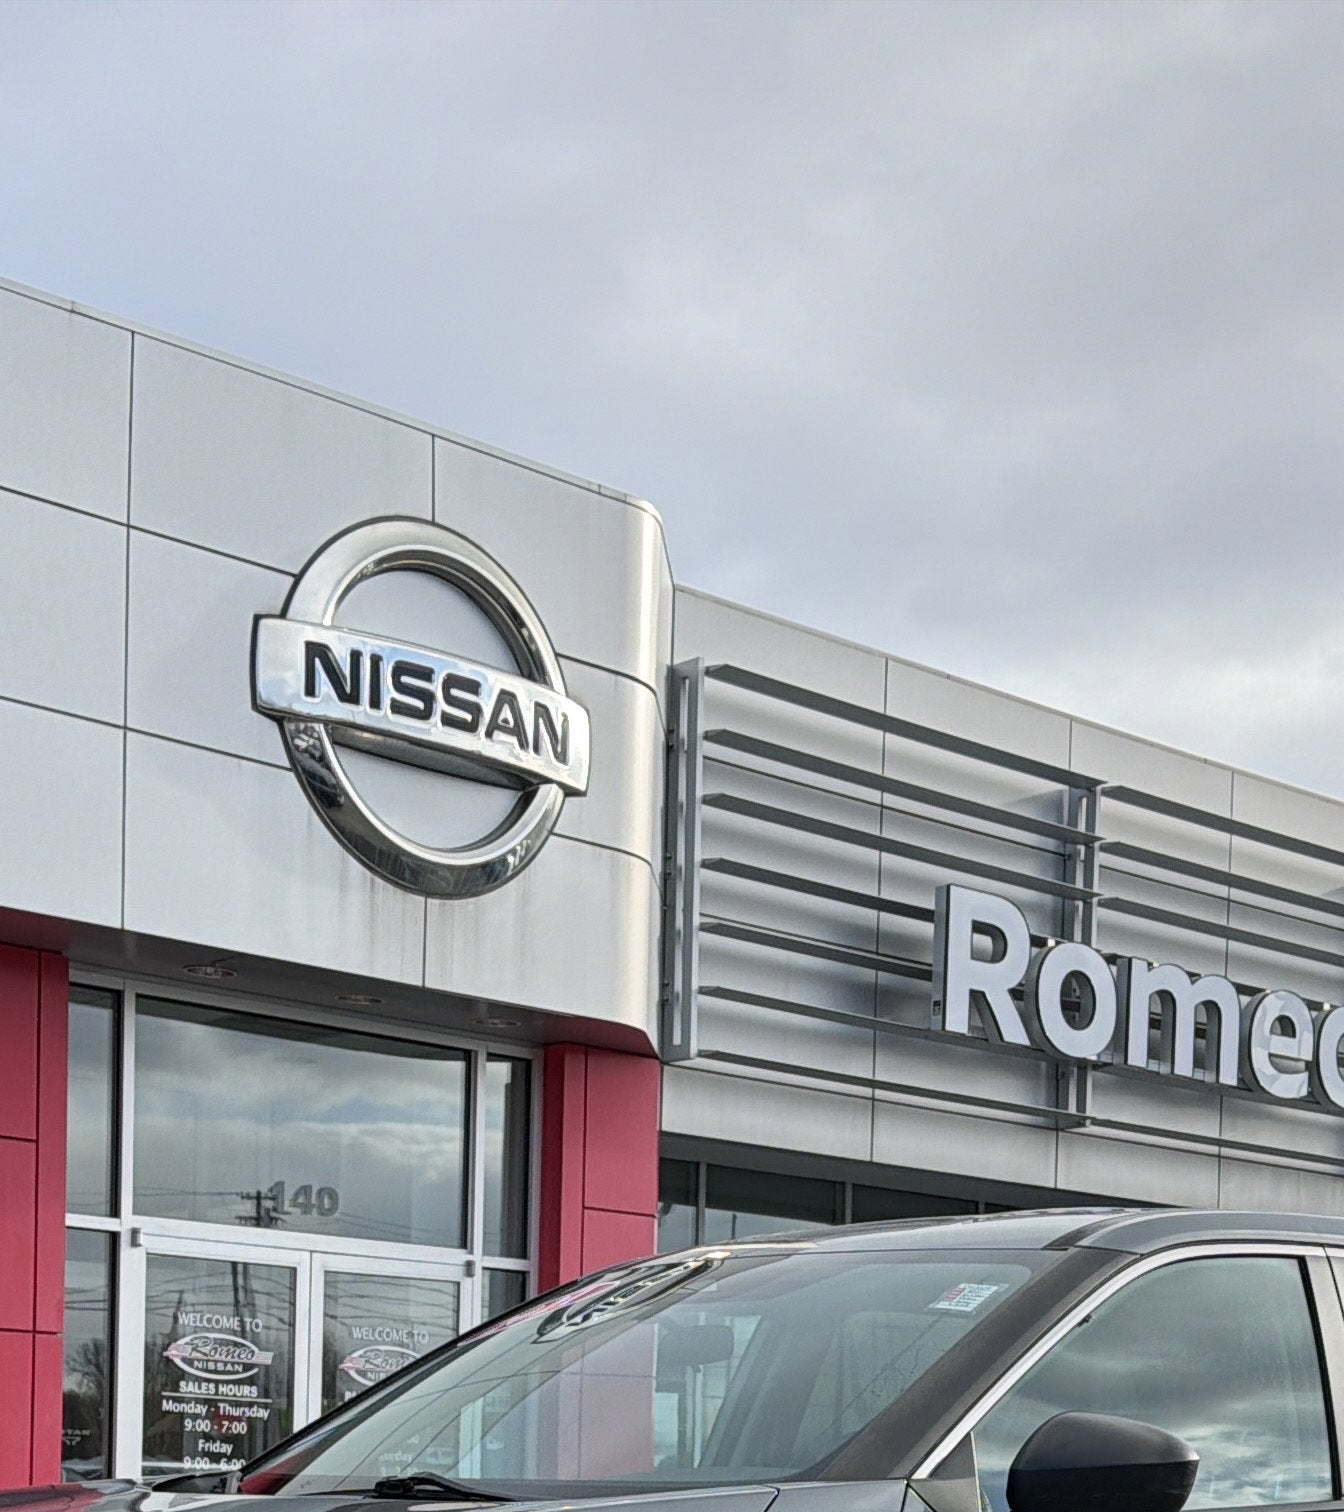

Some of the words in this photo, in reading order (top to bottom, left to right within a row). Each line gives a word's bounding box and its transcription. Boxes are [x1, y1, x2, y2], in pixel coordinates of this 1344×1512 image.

[303, 640, 571, 768] NISSAN
[268, 1181, 339, 1217] 140
[178, 1311, 241, 1331] WELCOME
[245, 1317, 263, 1332] TO
[352, 1326, 412, 1342] WELCOME
[413, 1330, 429, 1343] TO
[187, 1335, 256, 1361] Romeo
[194, 1360, 244, 1373] NISSAN
[179, 1380, 215, 1395] SALES
[218, 1383, 258, 1398] HOURS
[162, 1399, 208, 1416] Monday
[217, 1403, 270, 1420] Thursday
[184, 1419, 211, 1432] 9:00
[221, 1421, 247, 1434] 7:00
[198, 1439, 233, 1456] Friday
[184, 1456, 210, 1469] 9:00
[220, 1458, 247, 1470] 6:00
